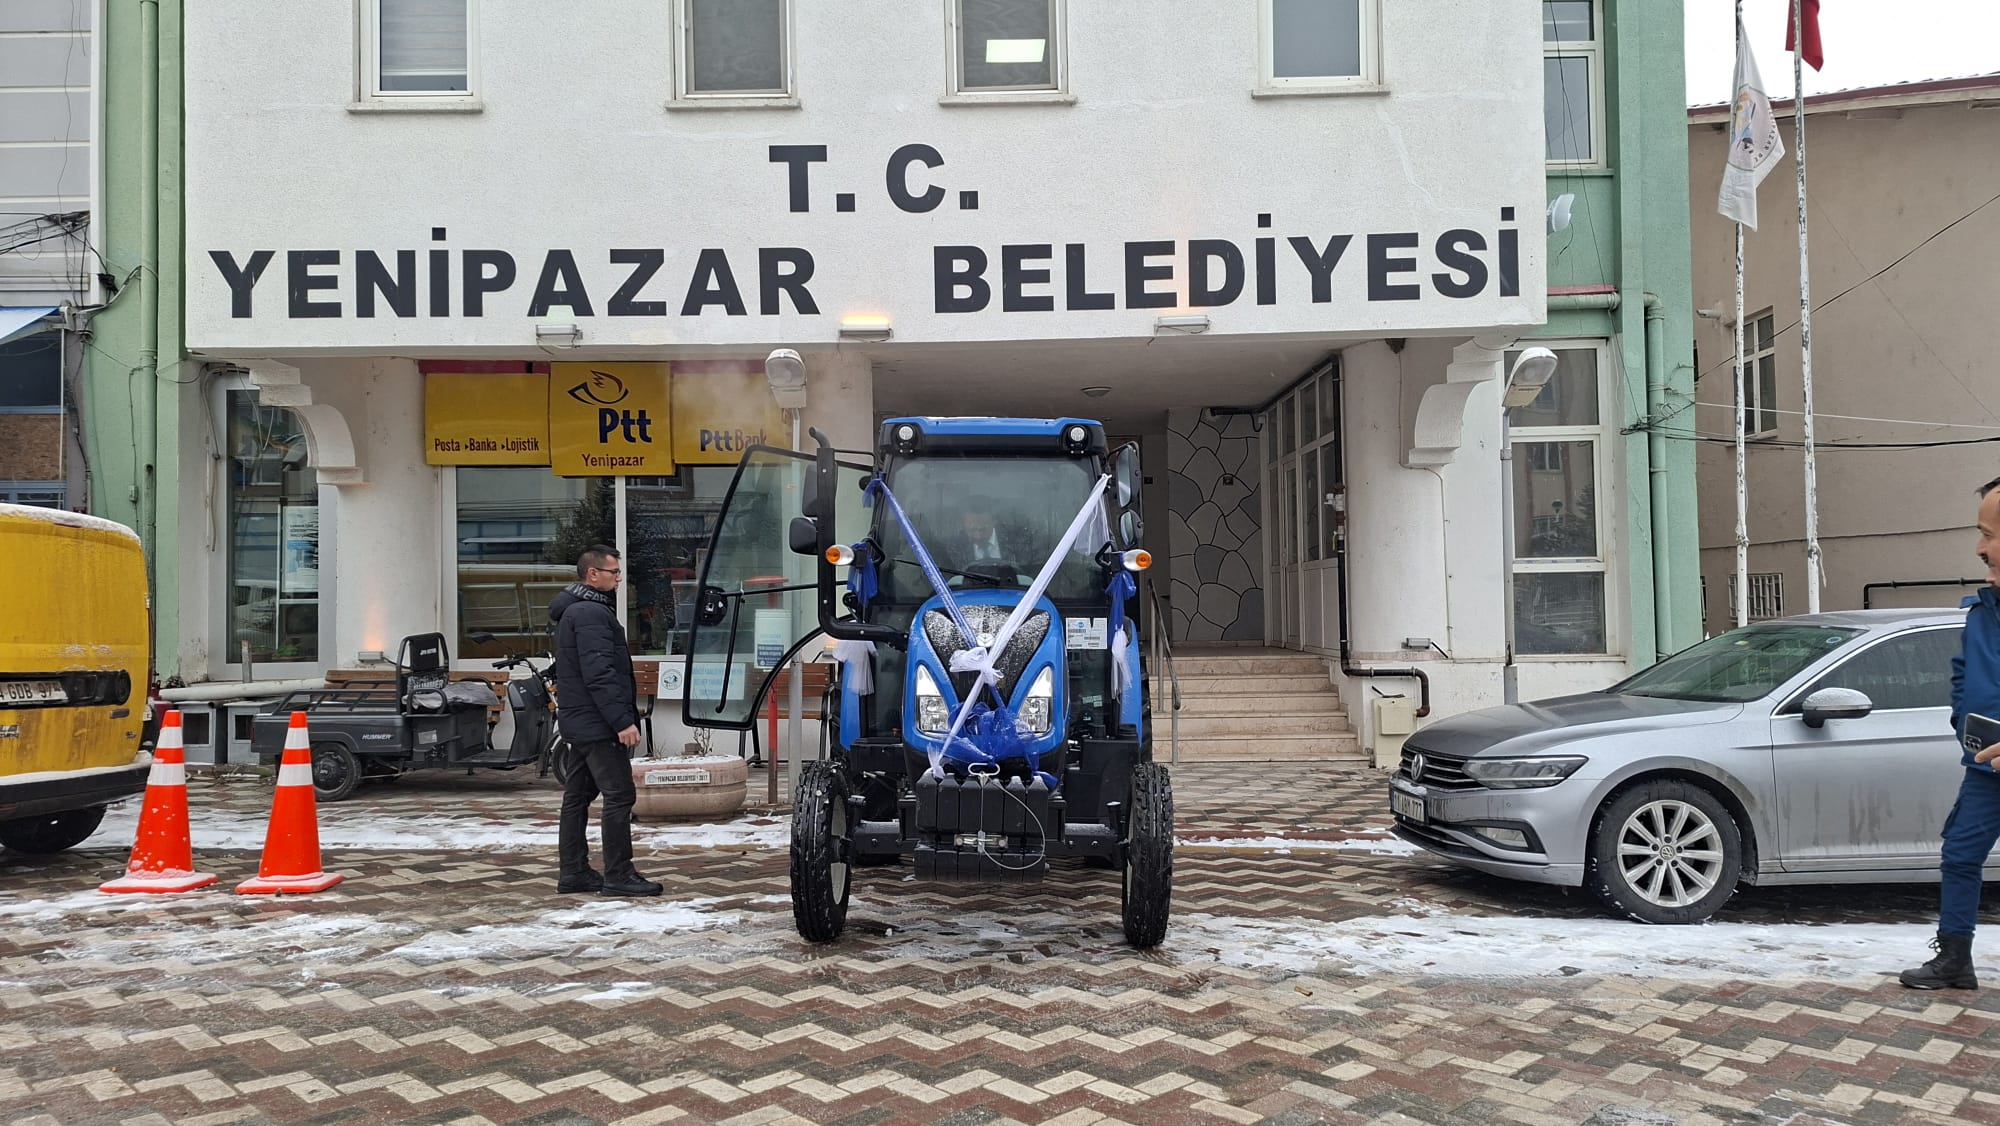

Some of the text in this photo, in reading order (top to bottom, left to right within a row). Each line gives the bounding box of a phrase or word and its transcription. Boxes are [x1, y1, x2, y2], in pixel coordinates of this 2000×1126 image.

[768, 143, 979, 214] T. C.
[207, 206, 1520, 319] YENİPAZAR BELEDİYESİ
[599, 408, 652, 443] Ptt
[434, 437, 539, 453] Posta Banka Lojistik
[582, 453, 644, 469] Yenipazar
[7, 682, 33, 700] GDB
